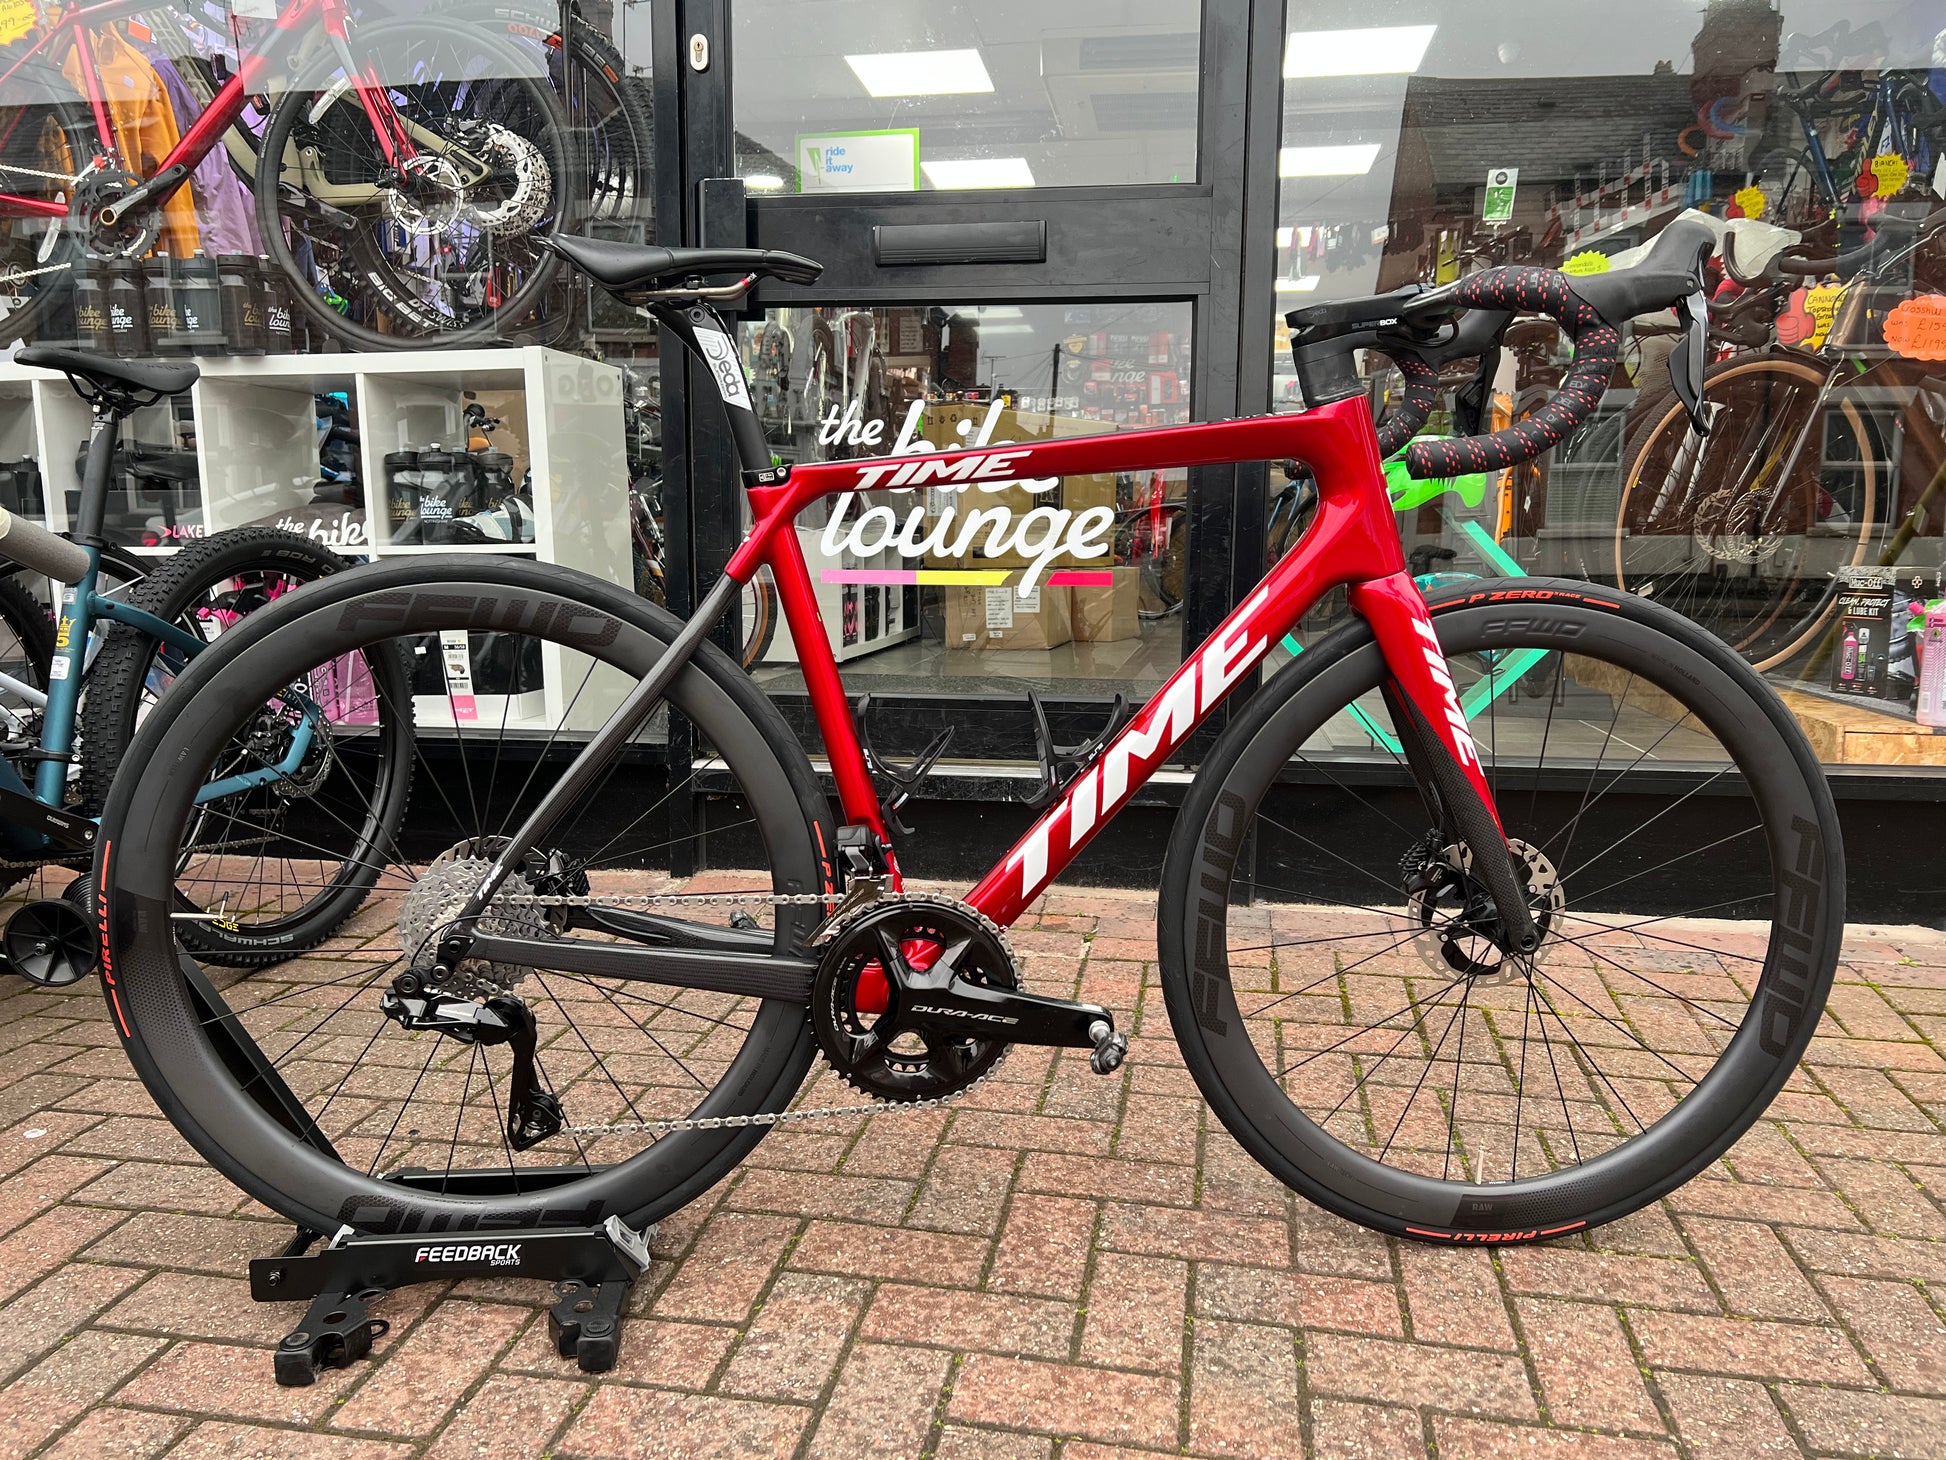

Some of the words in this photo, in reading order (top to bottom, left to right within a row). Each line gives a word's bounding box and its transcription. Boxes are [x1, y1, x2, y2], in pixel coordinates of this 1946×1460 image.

[825, 147, 846, 156] ride
[825, 156, 833, 165] it
[825, 164, 853, 173] away
[1352, 318, 1398, 330] SUPERBOX
[817, 400, 885, 446] the
[853, 450, 1033, 490] TIME
[424, 495, 447, 508] bike
[172, 524, 204, 539] LAKE
[275, 516, 306, 534] the
[819, 489, 1116, 599] lounge
[1468, 593, 1486, 604] P
[1488, 590, 1554, 601] ZERO
[1868, 608, 1879, 616] KIT
[1410, 616, 1486, 778] TIME
[1004, 584, 1269, 900] TIME
[98, 893, 116, 986] PIRELLI
[911, 1004, 1020, 1025] DURA-ACE
[1472, 1203, 1493, 1212] RAW
[1453, 1229, 1538, 1242] PIRELLI
[415, 1244, 522, 1263] FEEDBACK
[490, 1258, 521, 1266] SPORTS
